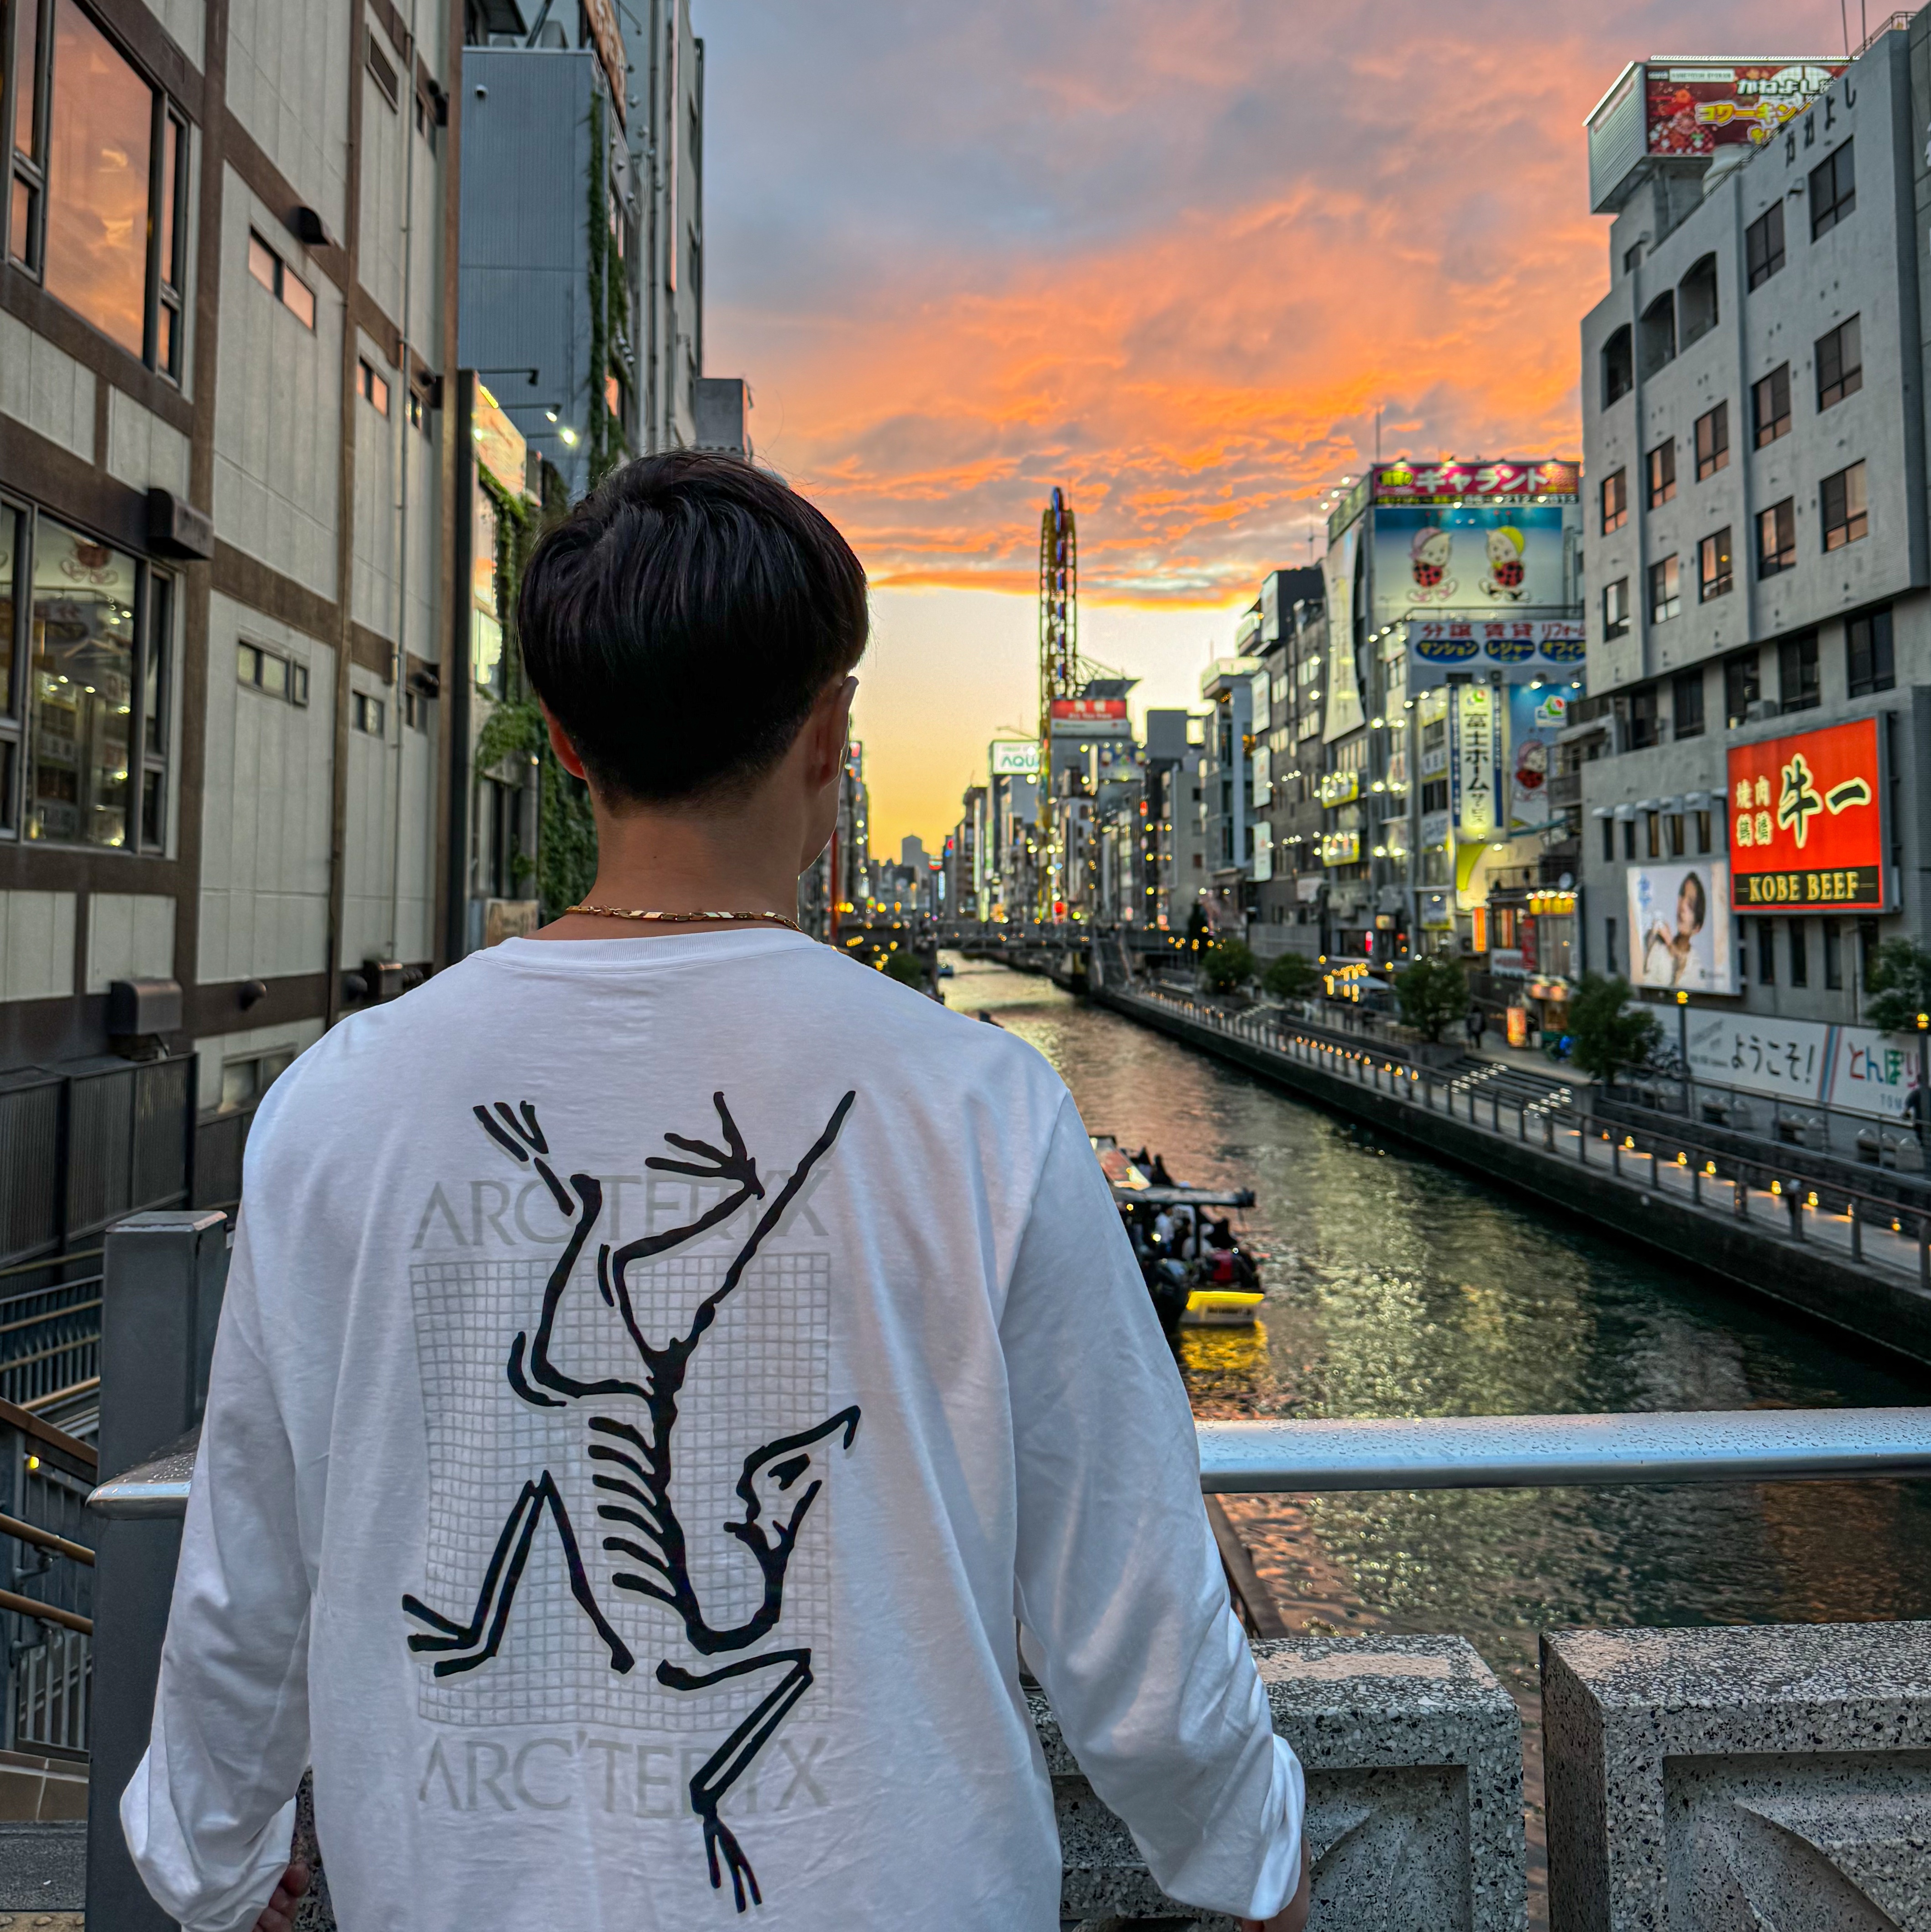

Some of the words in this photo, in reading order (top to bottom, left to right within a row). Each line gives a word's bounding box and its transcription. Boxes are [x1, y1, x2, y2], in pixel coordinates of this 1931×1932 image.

[1695, 99, 1812, 126] コワーキン
[1001, 755, 1036, 767] AQU
[1777, 753, 1871, 849] 牛一
[1748, 874, 1800, 902] KOBE
[1806, 871, 1859, 901] BEEF
